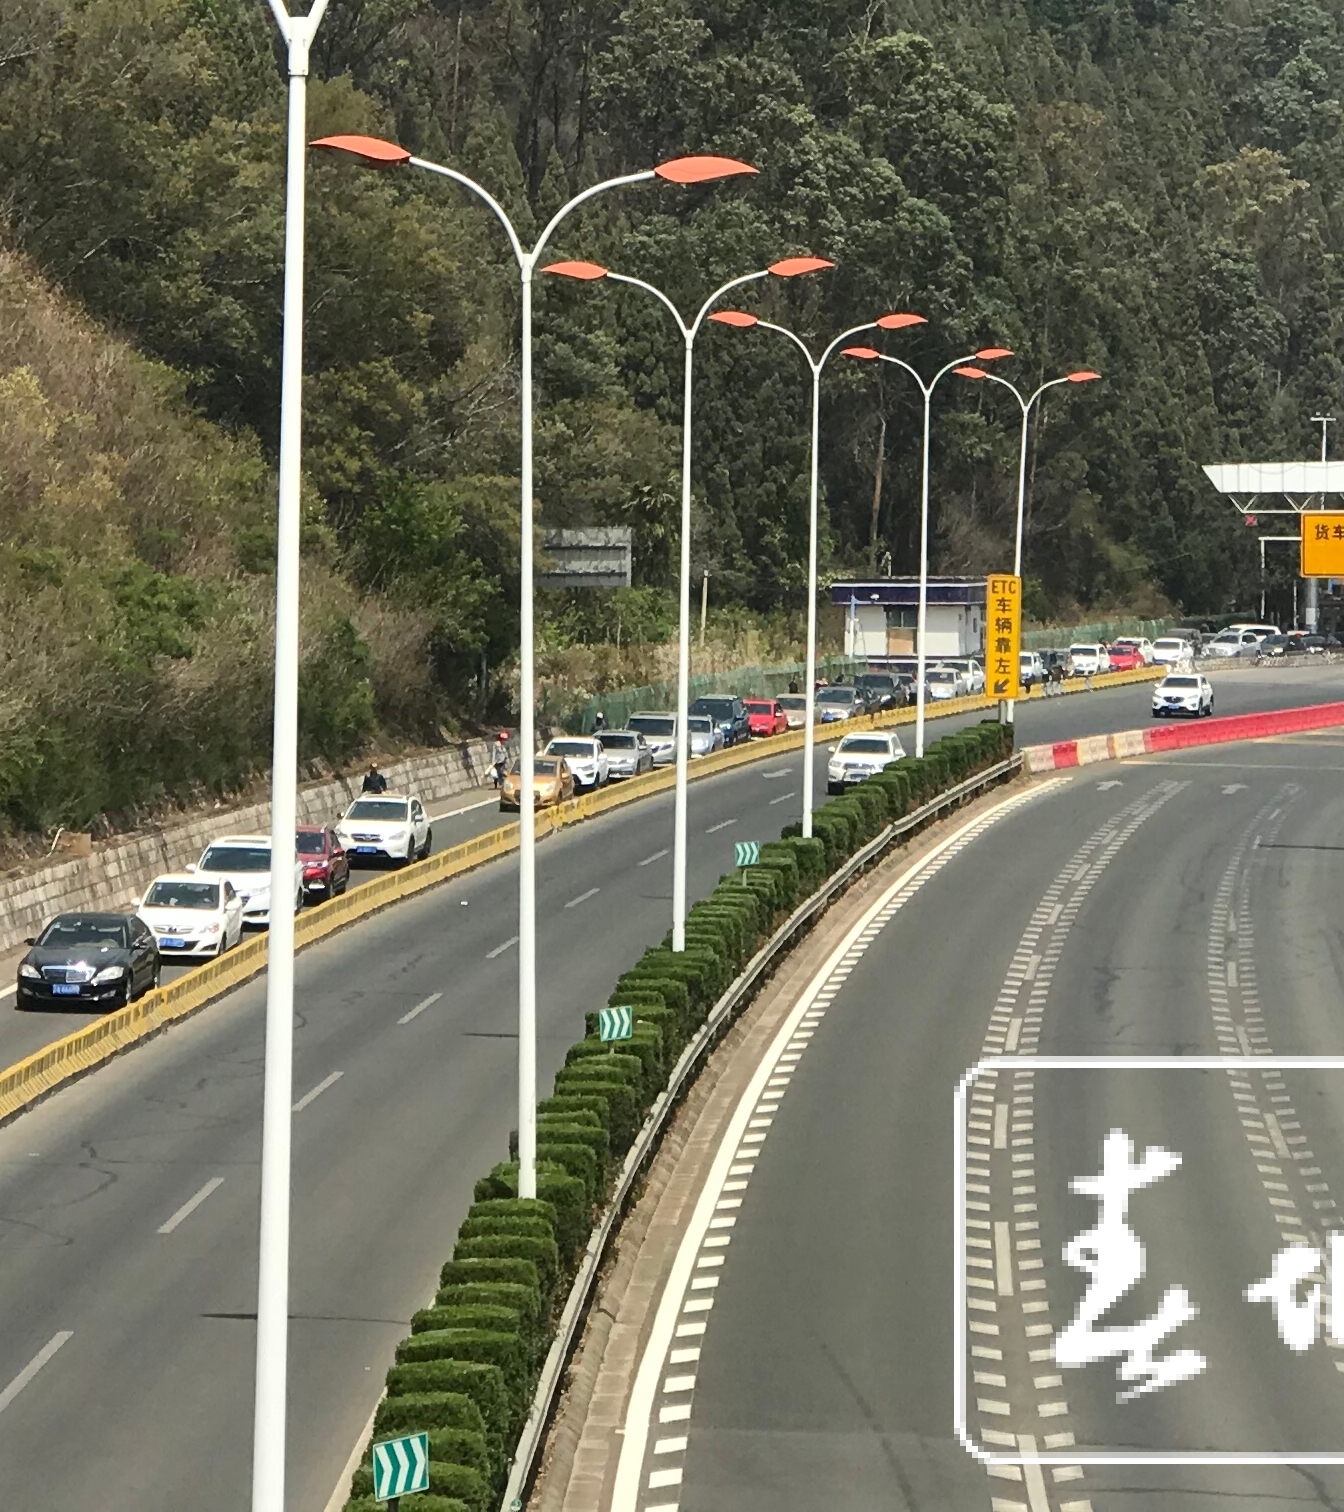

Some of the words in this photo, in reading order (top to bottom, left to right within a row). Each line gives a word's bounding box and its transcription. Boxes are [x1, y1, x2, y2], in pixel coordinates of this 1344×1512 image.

[991, 579, 1016, 594] ETC
[994, 596, 1012, 675] 车辆靠左
